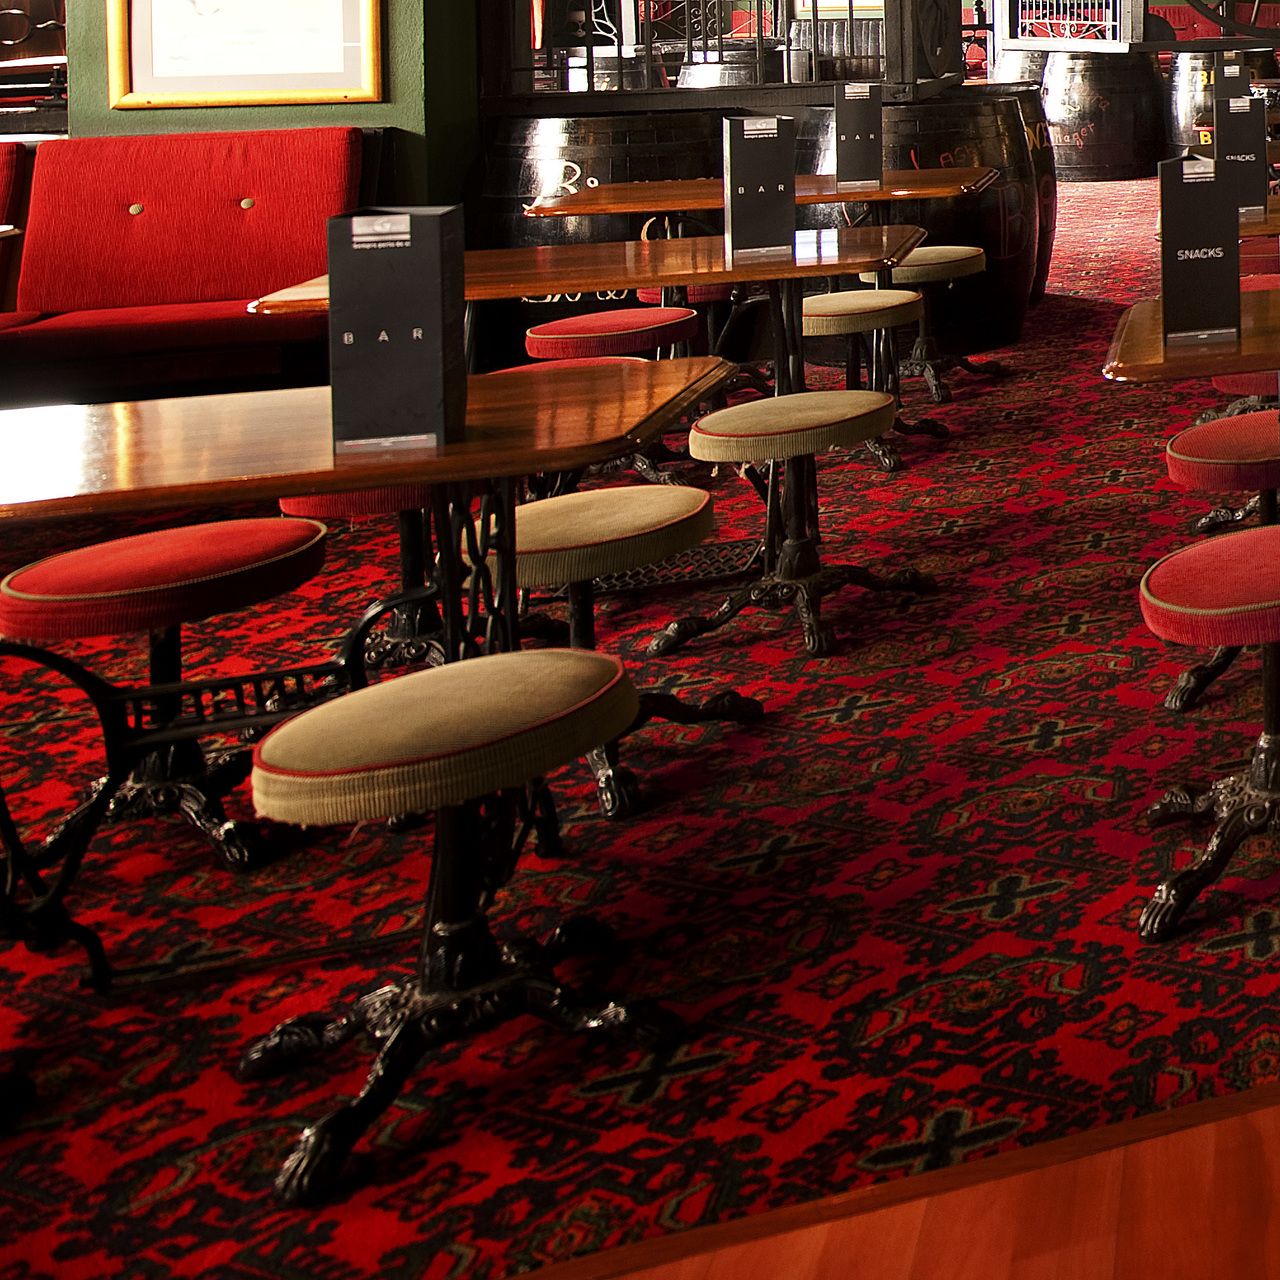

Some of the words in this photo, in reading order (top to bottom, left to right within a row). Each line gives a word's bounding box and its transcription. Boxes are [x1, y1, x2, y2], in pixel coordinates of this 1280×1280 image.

[840, 133, 875, 141] BAR
[738, 183, 785, 195] BAR
[1176, 247, 1225, 261] SNACKS
[343, 327, 423, 345] BAR
